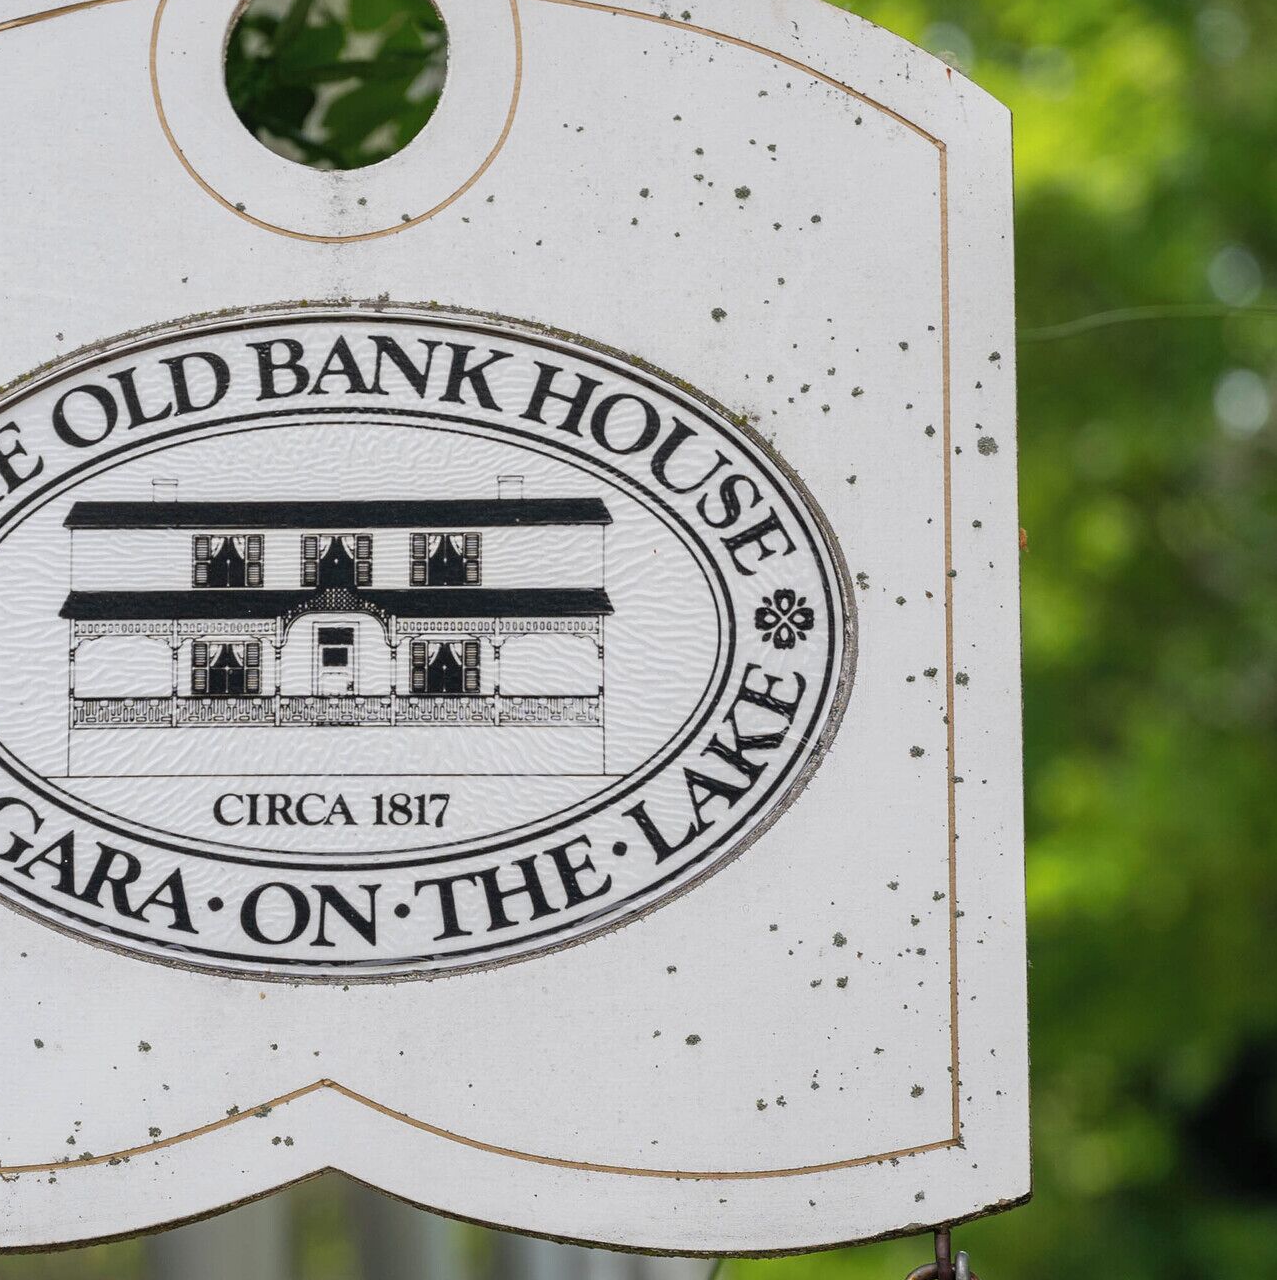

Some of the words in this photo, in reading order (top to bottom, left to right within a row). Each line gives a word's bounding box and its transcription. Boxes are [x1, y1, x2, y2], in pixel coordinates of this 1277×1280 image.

[52, 351, 231, 449] OLD
[245, 334, 514, 413] BANK
[518, 360, 797, 577] HOUSE
[213, 793, 358, 827] CIRCA
[371, 792, 450, 828] 1817
[240, 881, 382, 947] ON
[414, 834, 612, 942] THE
[621, 662, 807, 866] LAKE
